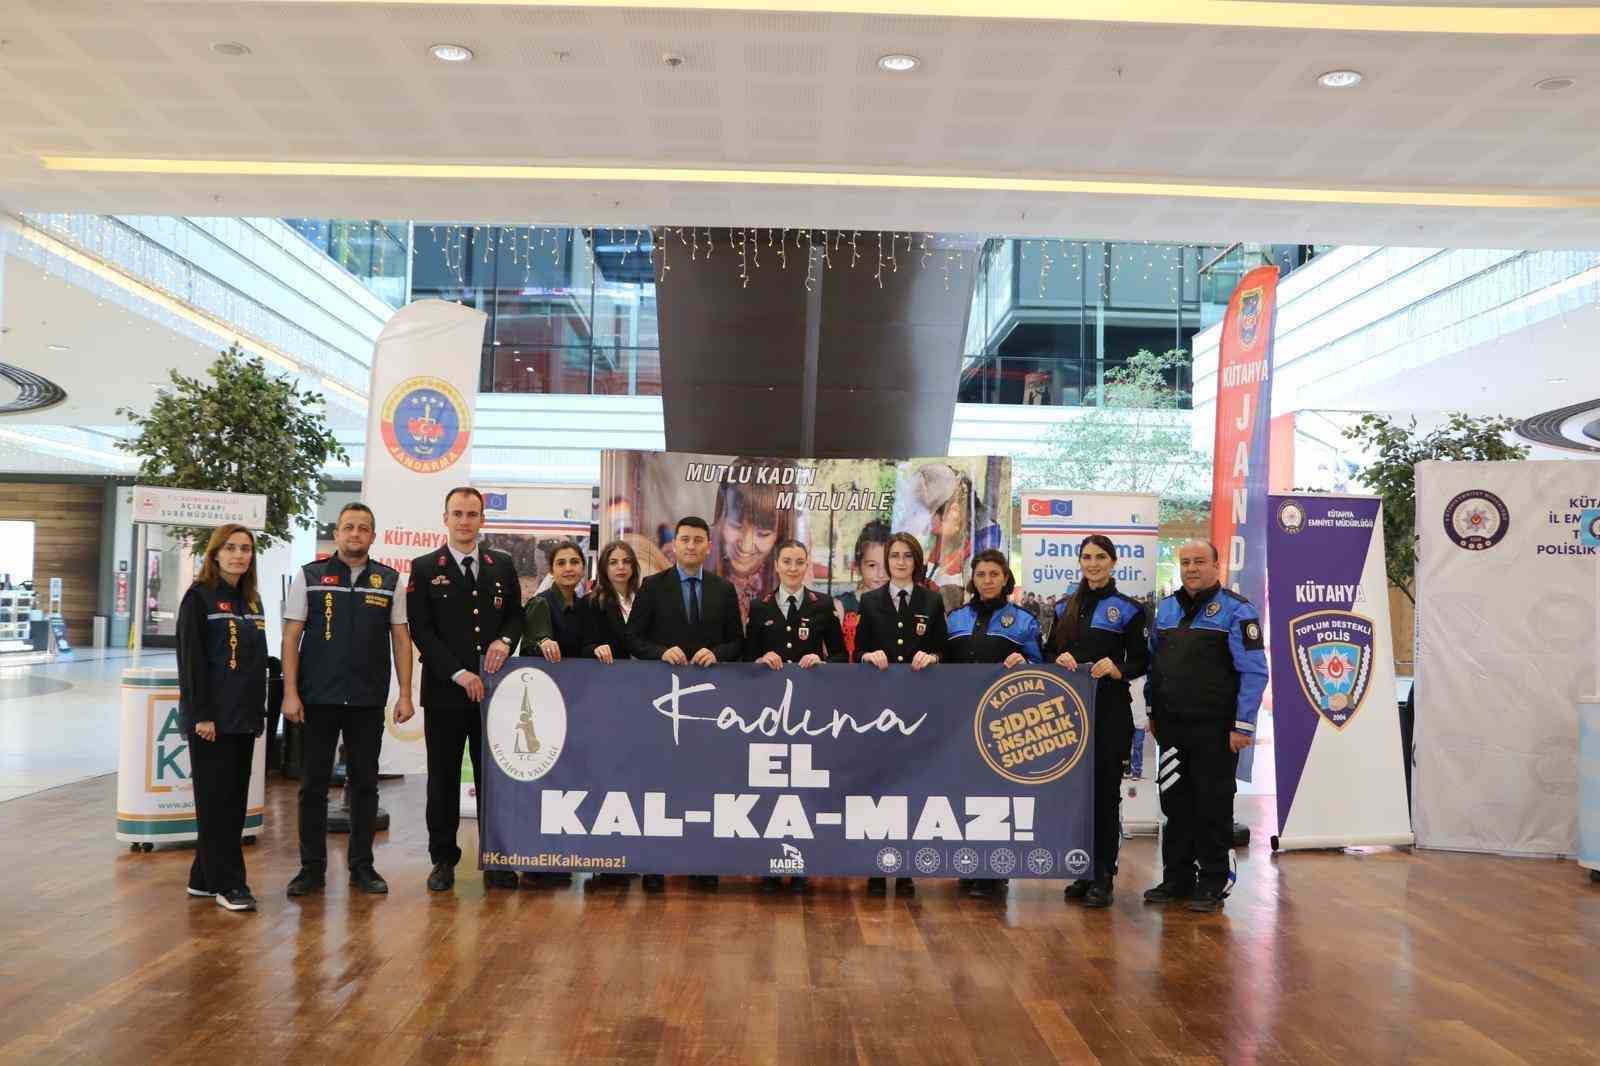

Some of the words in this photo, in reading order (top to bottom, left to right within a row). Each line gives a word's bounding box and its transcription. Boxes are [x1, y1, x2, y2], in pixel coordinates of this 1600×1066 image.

[390, 446, 458, 472] JANDARMA
[686, 463, 751, 483] MUTLU
[756, 466, 816, 486] KADIN
[775, 491, 843, 511] MUTLU
[847, 488, 890, 511] AİLE
[1549, 510, 1560, 524] İL
[383, 526, 449, 548] KÜTAHYA
[1296, 580, 1367, 602] KÜTAHYA
[1296, 621, 1329, 636] TOPLUM
[1317, 629, 1350, 642] POLİS
[989, 680, 1046, 709] KADINA
[652, 673, 927, 745] Kadına
[749, 743, 830, 788] EL
[540, 789, 1036, 841] KAL-KA-MAZ!
[482, 852, 626, 868] #KadınaElKalkamaz!
[770, 858, 804, 869] KADES
